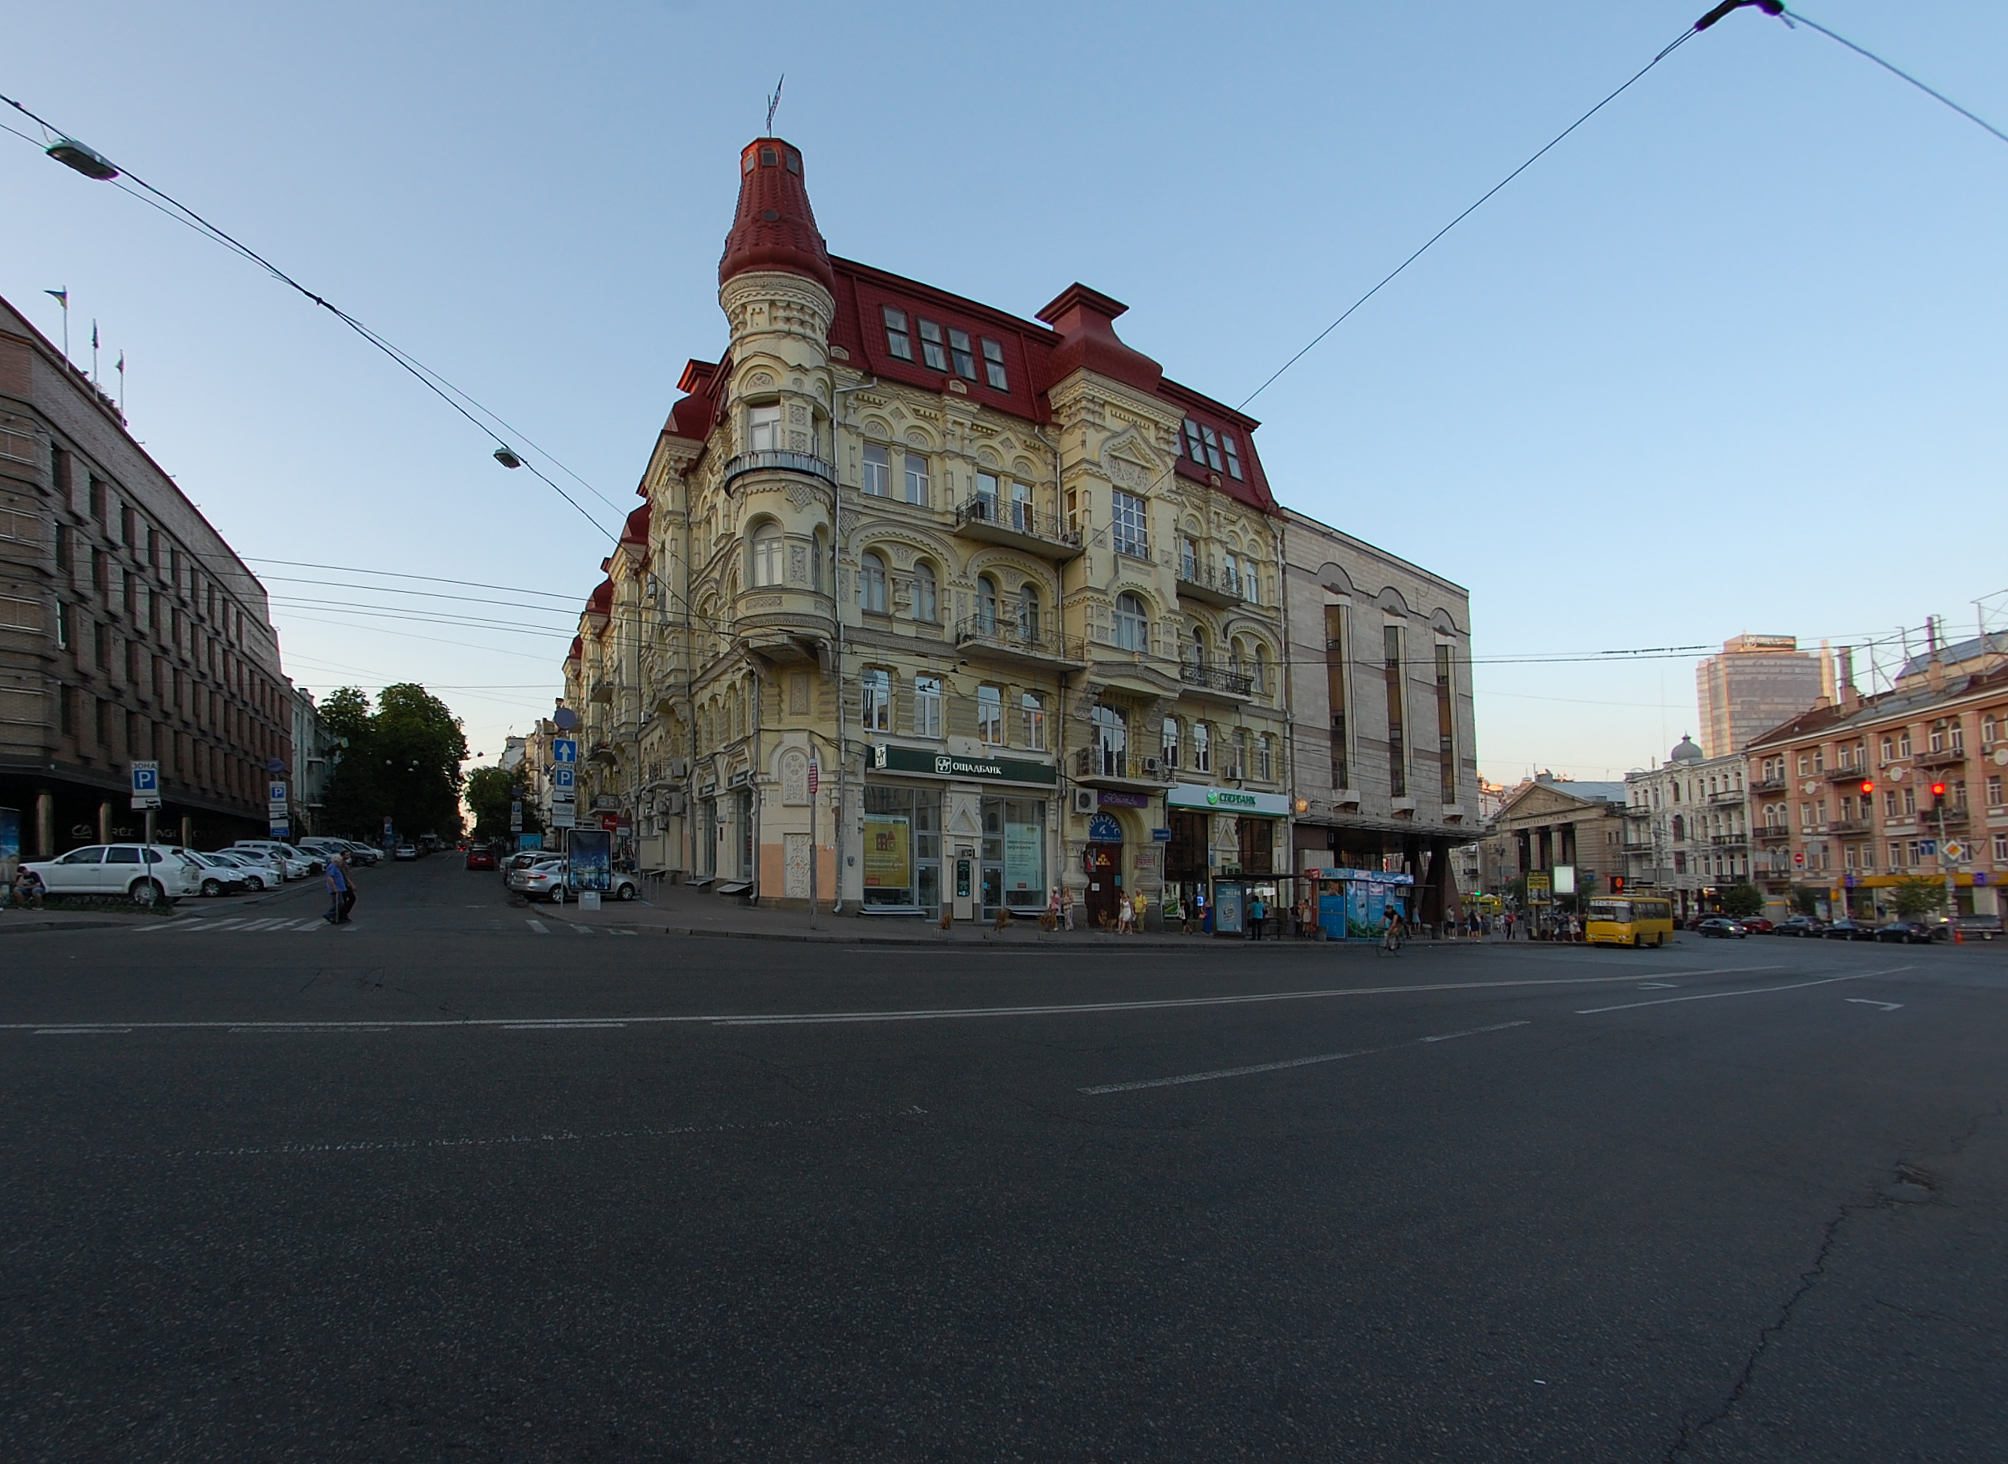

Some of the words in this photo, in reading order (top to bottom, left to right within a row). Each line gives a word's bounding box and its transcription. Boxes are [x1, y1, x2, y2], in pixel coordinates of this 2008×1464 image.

[952, 762, 1002, 775] ОЩАДБАНК
[138, 771, 151, 788] P
[560, 771, 570, 785] P
[274, 787, 283, 798] P
[1219, 792, 1257, 805] СБЕРБАНК
